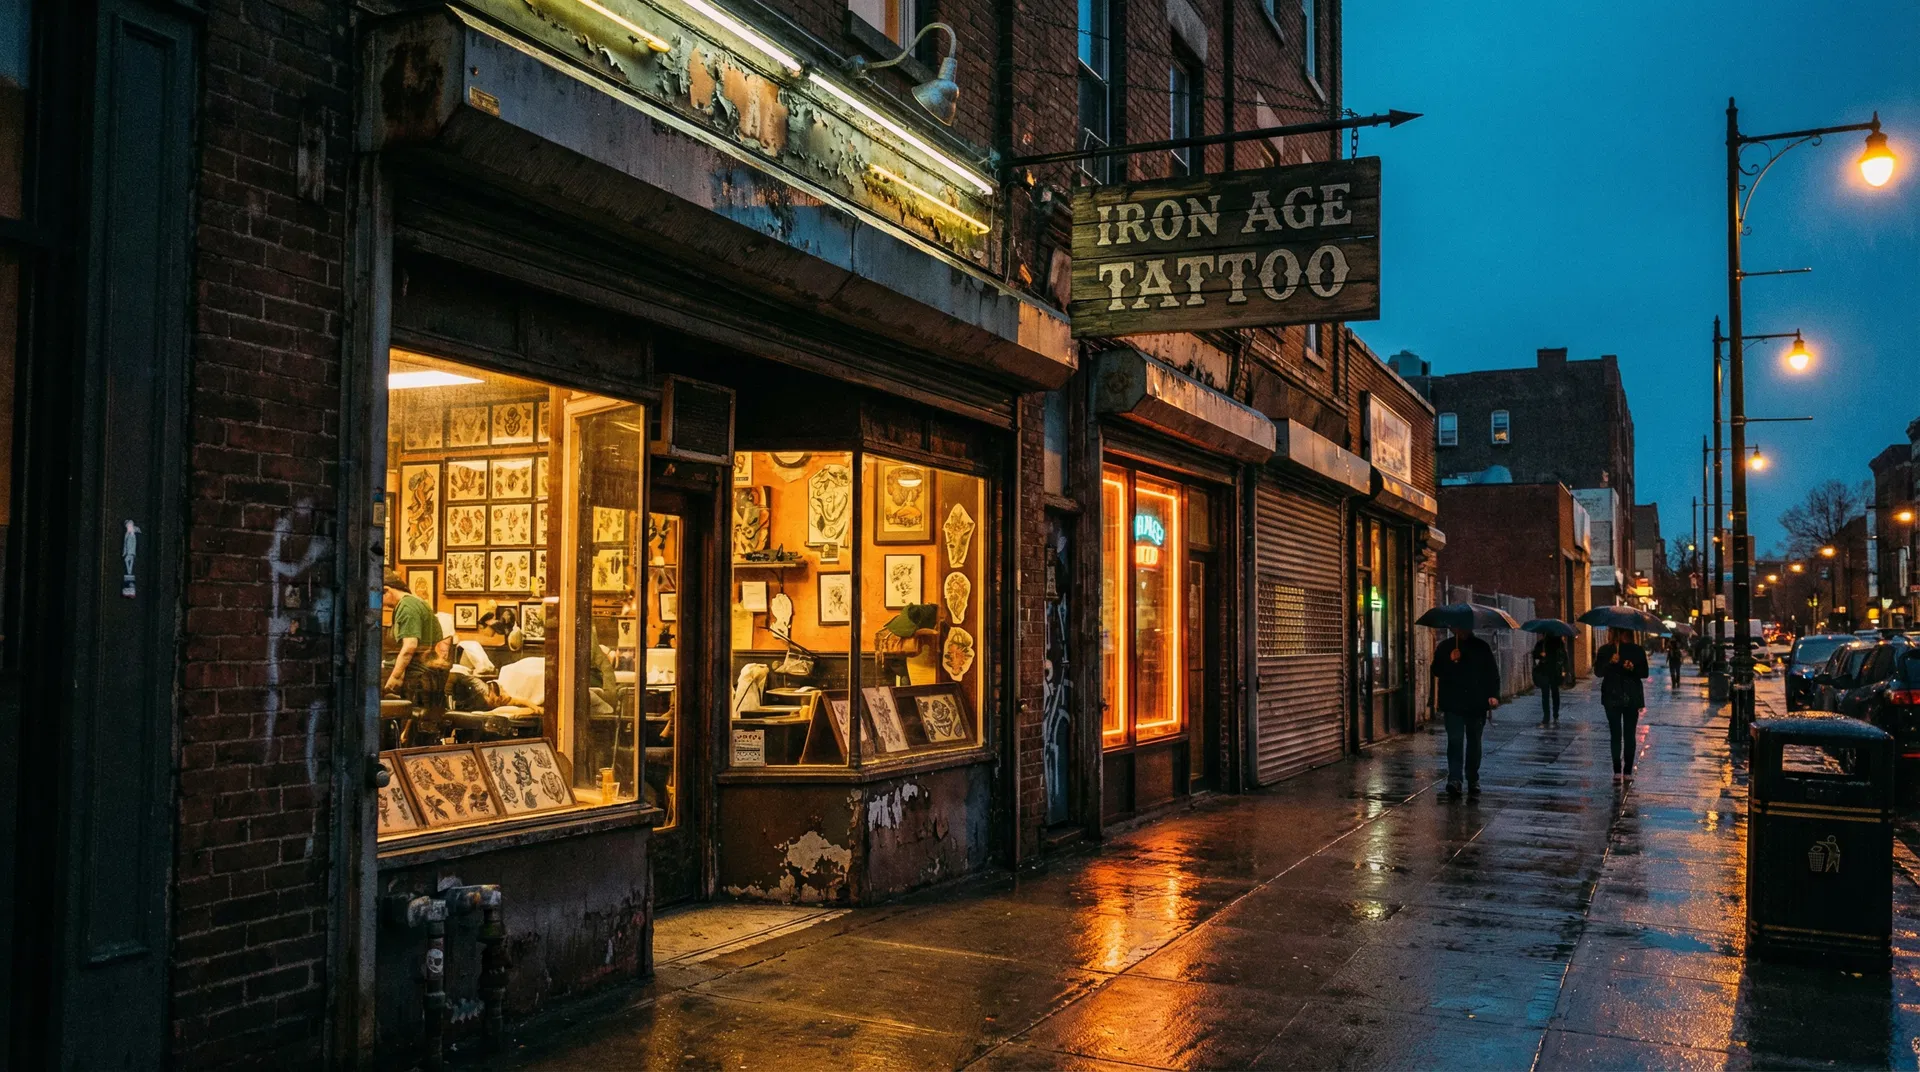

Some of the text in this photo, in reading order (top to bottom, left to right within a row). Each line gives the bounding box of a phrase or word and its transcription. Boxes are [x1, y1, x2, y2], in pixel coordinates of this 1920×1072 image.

[1097, 183, 1352, 246] IRON AGE
[1098, 244, 1351, 311] TATTOO
